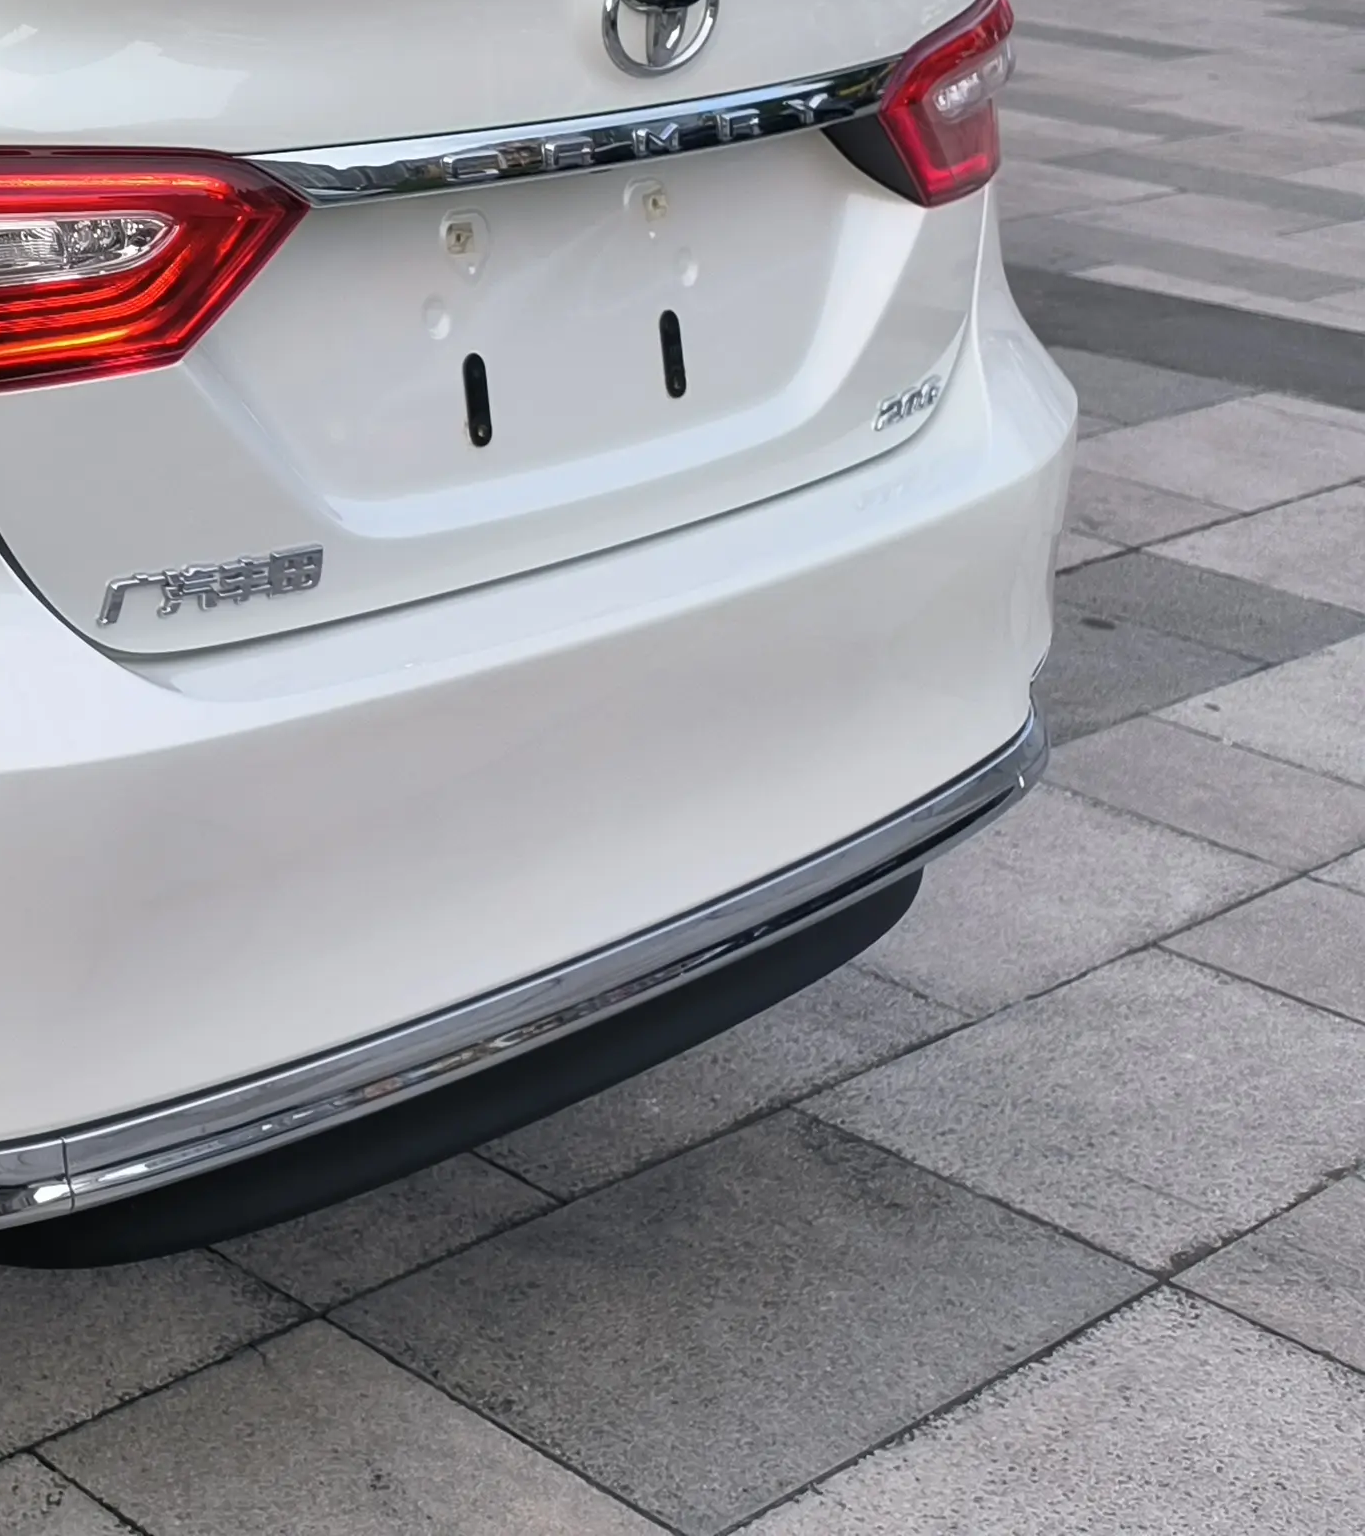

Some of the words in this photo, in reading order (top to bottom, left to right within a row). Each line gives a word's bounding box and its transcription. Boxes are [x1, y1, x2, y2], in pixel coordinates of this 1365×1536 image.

[440, 93, 830, 183] CAMRY
[97, 543, 324, 626] 广汽丰田
